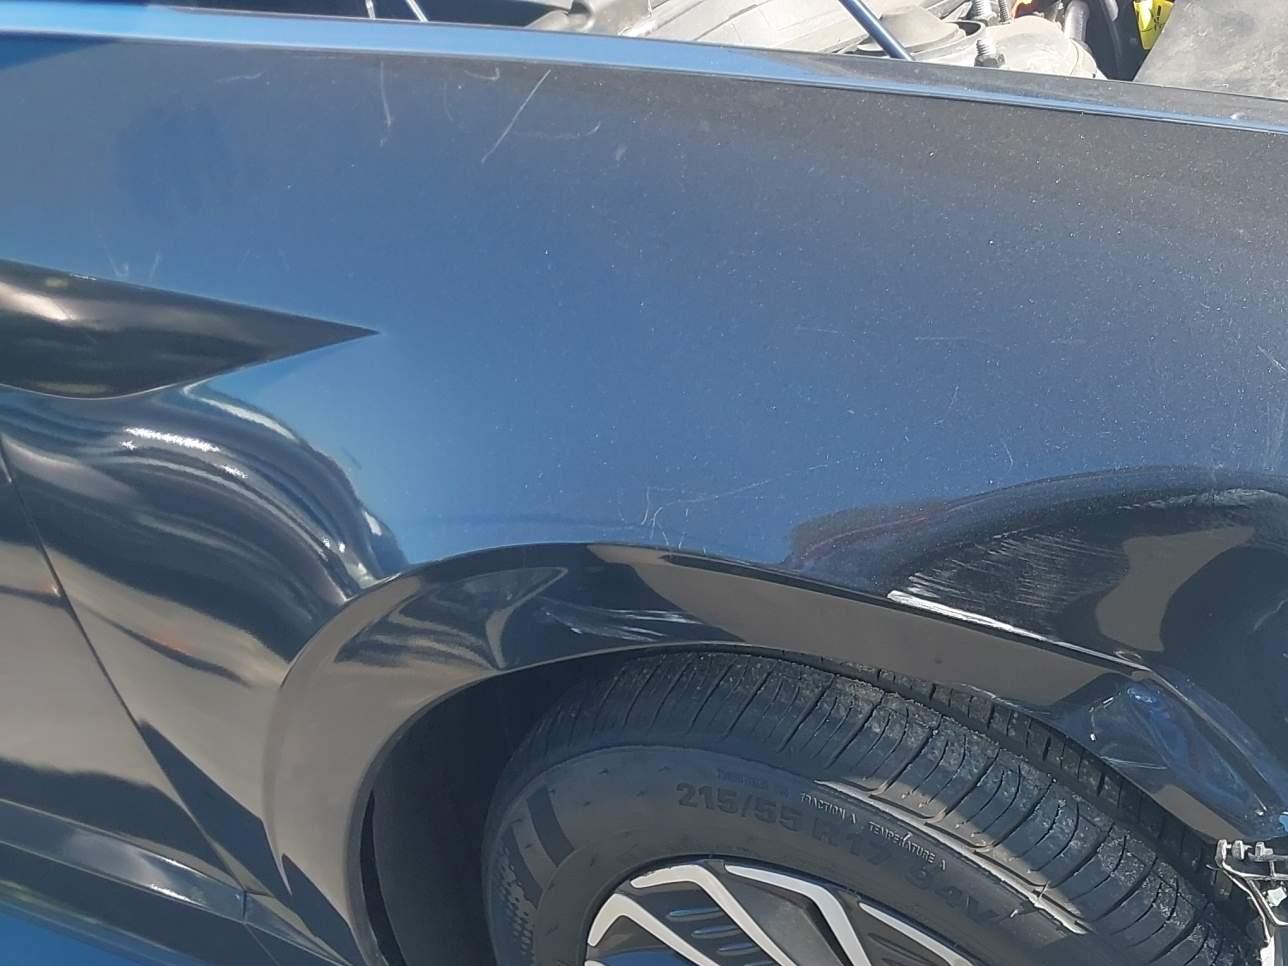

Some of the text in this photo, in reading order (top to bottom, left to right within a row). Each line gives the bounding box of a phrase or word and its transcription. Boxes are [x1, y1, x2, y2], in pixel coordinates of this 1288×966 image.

[676, 782, 803, 832] 215/55
[800, 791, 847, 821] TRACTION
[868, 820, 936, 864] TEMPERATURE
